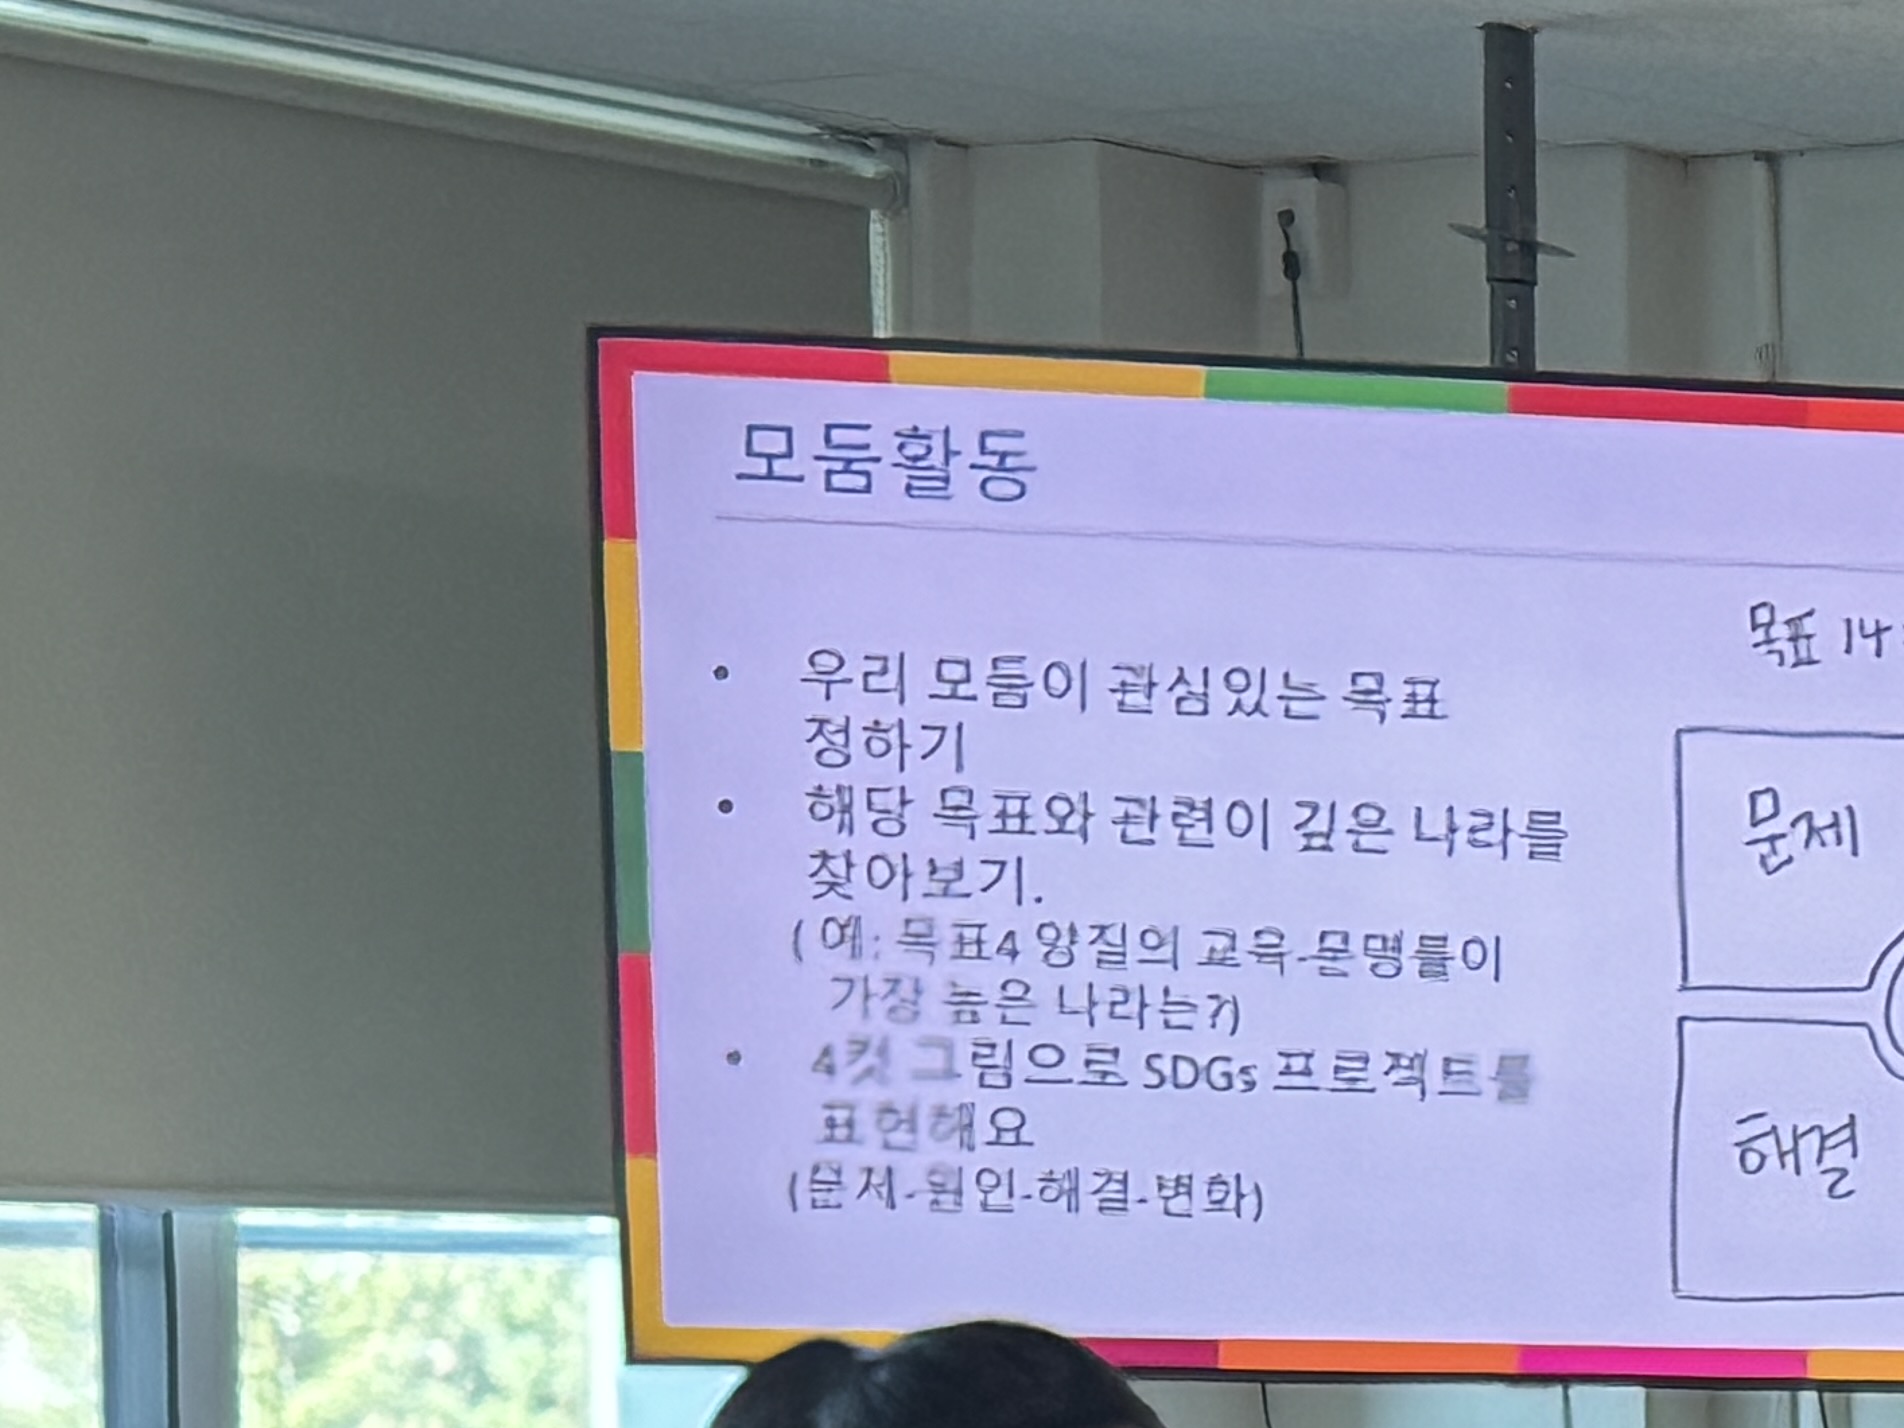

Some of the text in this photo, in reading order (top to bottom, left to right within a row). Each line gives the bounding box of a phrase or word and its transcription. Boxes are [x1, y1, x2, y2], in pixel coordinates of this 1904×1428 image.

[734, 422, 1038, 502] 모둠활동
[1749, 601, 1822, 668] 목표
[799, 648, 906, 707] 우리
[1107, 662, 1328, 720] 관심있는
[1341, 670, 1450, 726] 목표
[803, 714, 965, 775] 정하기
[804, 783, 1570, 863] 해당 목표와 관련이 깊은 나라를
[1743, 786, 1861, 875] 문제
[807, 848, 1044, 907] 찾아보기.
[1035, 921, 1180, 971] 양질의
[830, 974, 926, 1026] 가장
[909, 1036, 1130, 1090] 그림으로
[1142, 1052, 1259, 1094] SDGs
[1732, 1110, 1860, 1199] 해결
